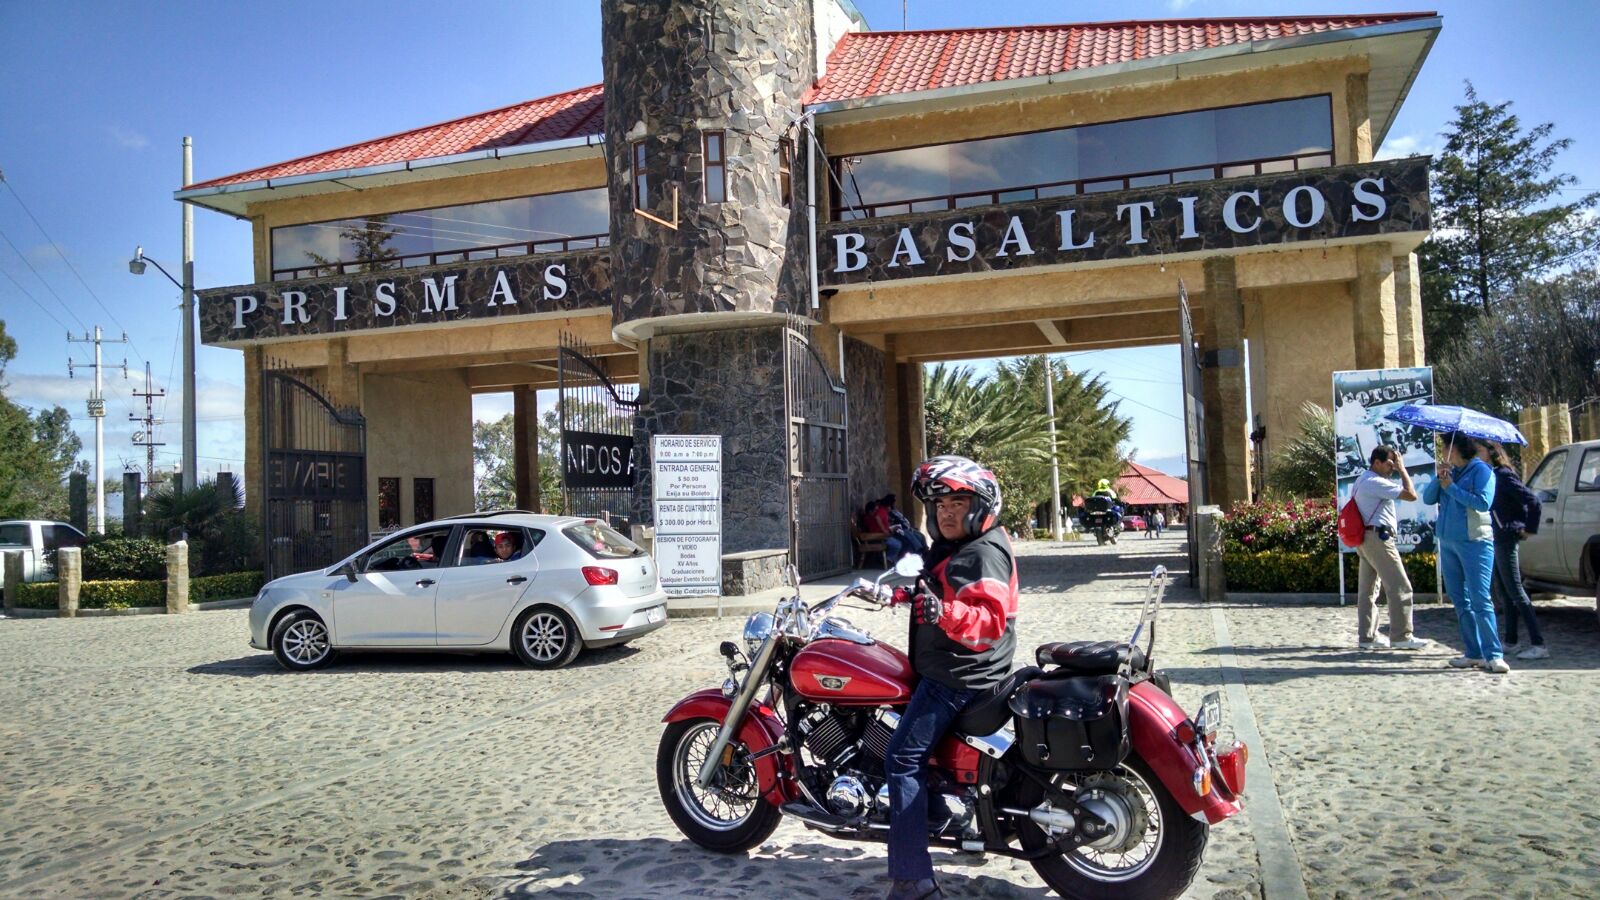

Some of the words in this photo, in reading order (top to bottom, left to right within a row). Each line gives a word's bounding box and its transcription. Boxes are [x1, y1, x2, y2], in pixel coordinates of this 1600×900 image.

[232, 263, 568, 330] PRISMAS
[832, 177, 1388, 273] BASALTICOS
[660, 439, 684, 447] HORARIO
[685, 439, 692, 447] DE
[693, 439, 717, 447] SERVICIO
[567, 443, 622, 475] NIDOS
[659, 464, 688, 472] ENTRADA
[690, 464, 718, 472] GENERAL
[659, 505, 676, 513] RENTA
[677, 505, 684, 513] DE
